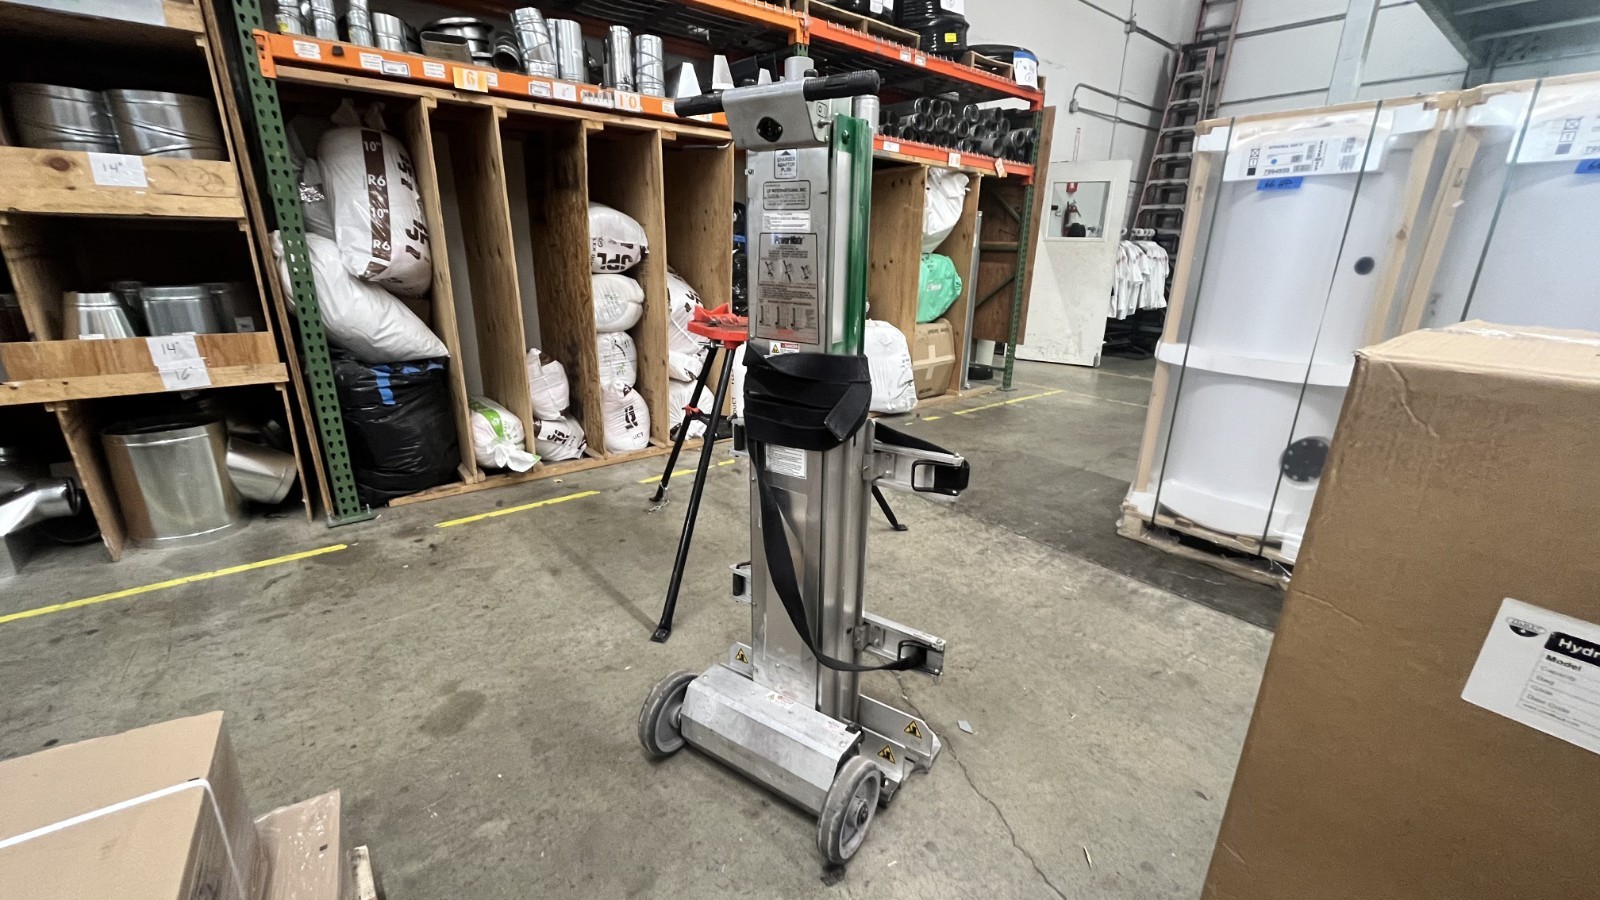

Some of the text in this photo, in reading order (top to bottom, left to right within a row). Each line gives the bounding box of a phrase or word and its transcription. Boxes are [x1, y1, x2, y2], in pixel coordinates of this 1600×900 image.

[367, 173, 386, 187] R6
[372, 239, 391, 251] R6
[1545, 654, 1582, 672] Model
